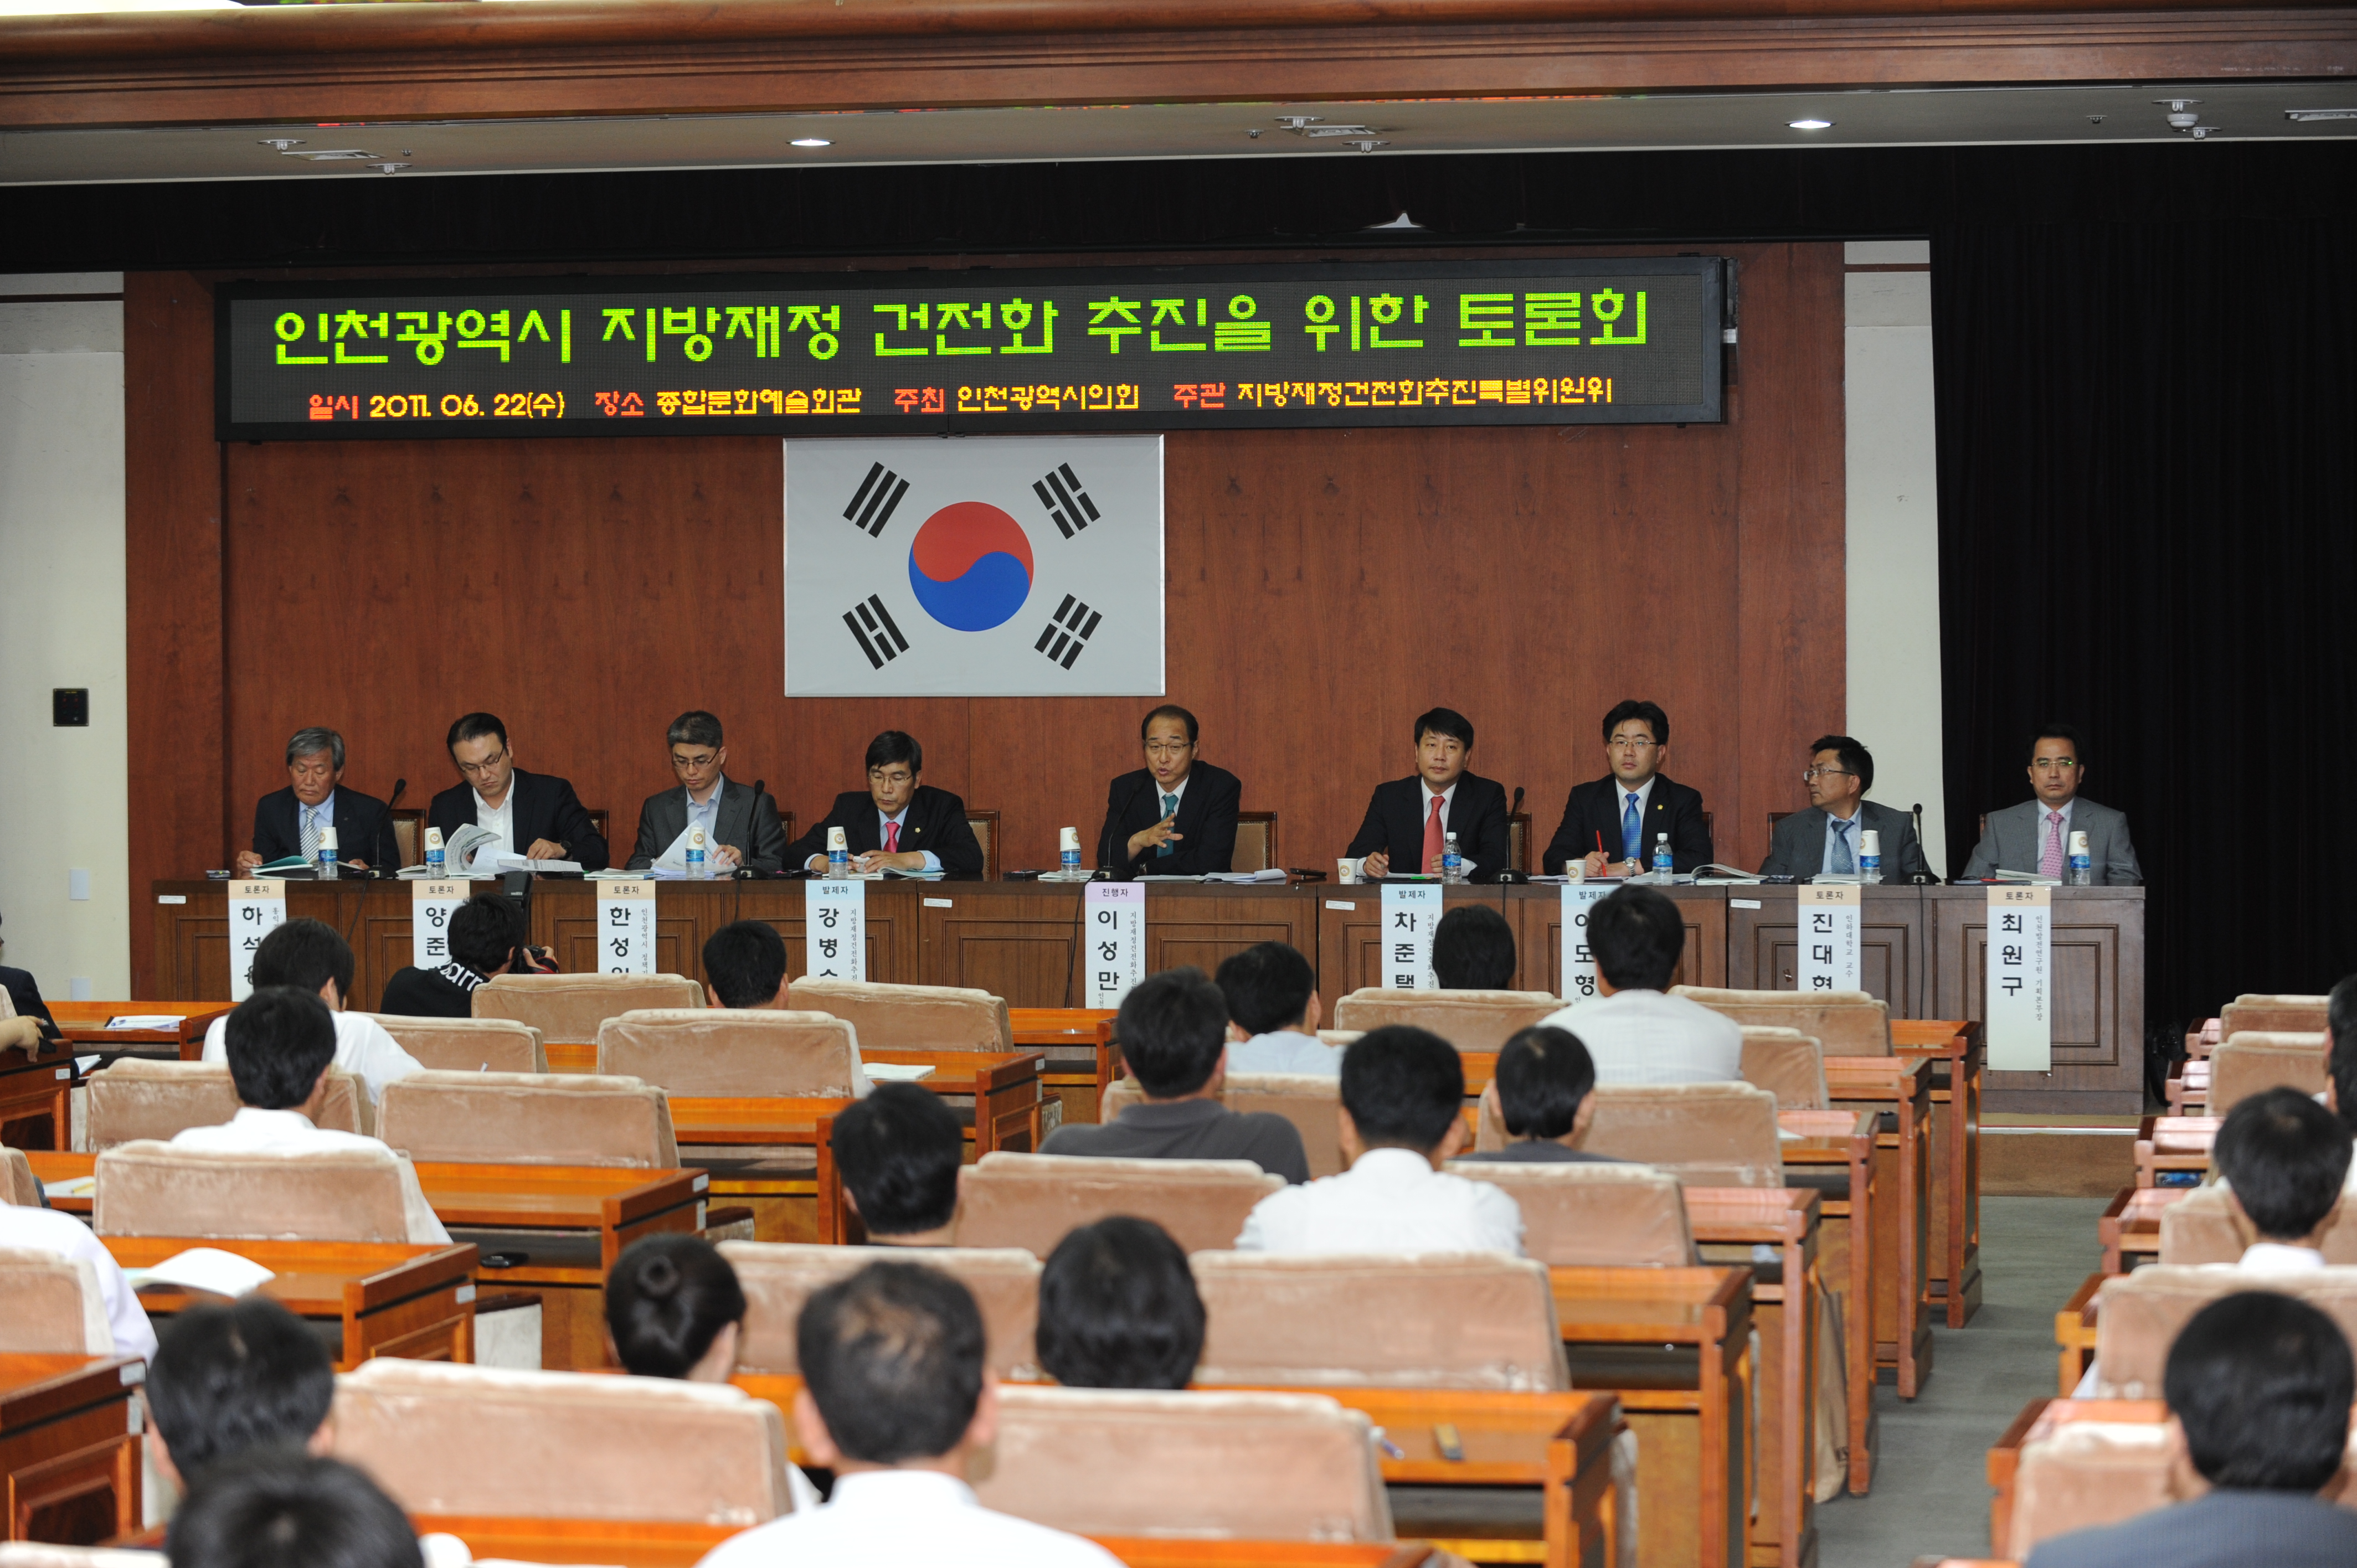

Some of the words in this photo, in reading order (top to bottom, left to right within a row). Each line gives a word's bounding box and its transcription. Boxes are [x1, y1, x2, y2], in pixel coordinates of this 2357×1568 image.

[274, 309, 571, 365] 인천광역시
[602, 305, 840, 362] 지방재정
[873, 298, 1059, 356] 건전화
[1087, 294, 1272, 353] 추진을
[1304, 293, 1429, 351] 위한
[1458, 287, 1646, 347] 토론회
[309, 394, 359, 420] 일시
[369, 394, 432, 417] 2011.
[440, 394, 485, 416] 06.
[493, 391, 565, 419] 22(수)
[595, 390, 645, 416] 장소
[656, 388, 862, 415] 종합문화예술회관
[894, 386, 944, 412] 주최
[957, 383, 1139, 412] 인천광역시의회
[1173, 381, 1226, 408] 주관
[245, 885, 270, 894] 토론자
[614, 886, 639, 894] 토론자
[822, 886, 848, 894] 발제자
[1102, 888, 1129, 897] 진행자
[1399, 890, 1426, 899] 발제자
[1579, 891, 1606, 899] 발제자
[1815, 891, 1844, 900] 토론자
[2005, 891, 2034, 900] 토론자
[426, 907, 447, 971] 양준
[1098, 910, 1120, 991] 이성만
[1394, 911, 1417, 989] 차준택
[2001, 914, 2023, 996] 최원구
[1845, 962, 1853, 977] 교수
